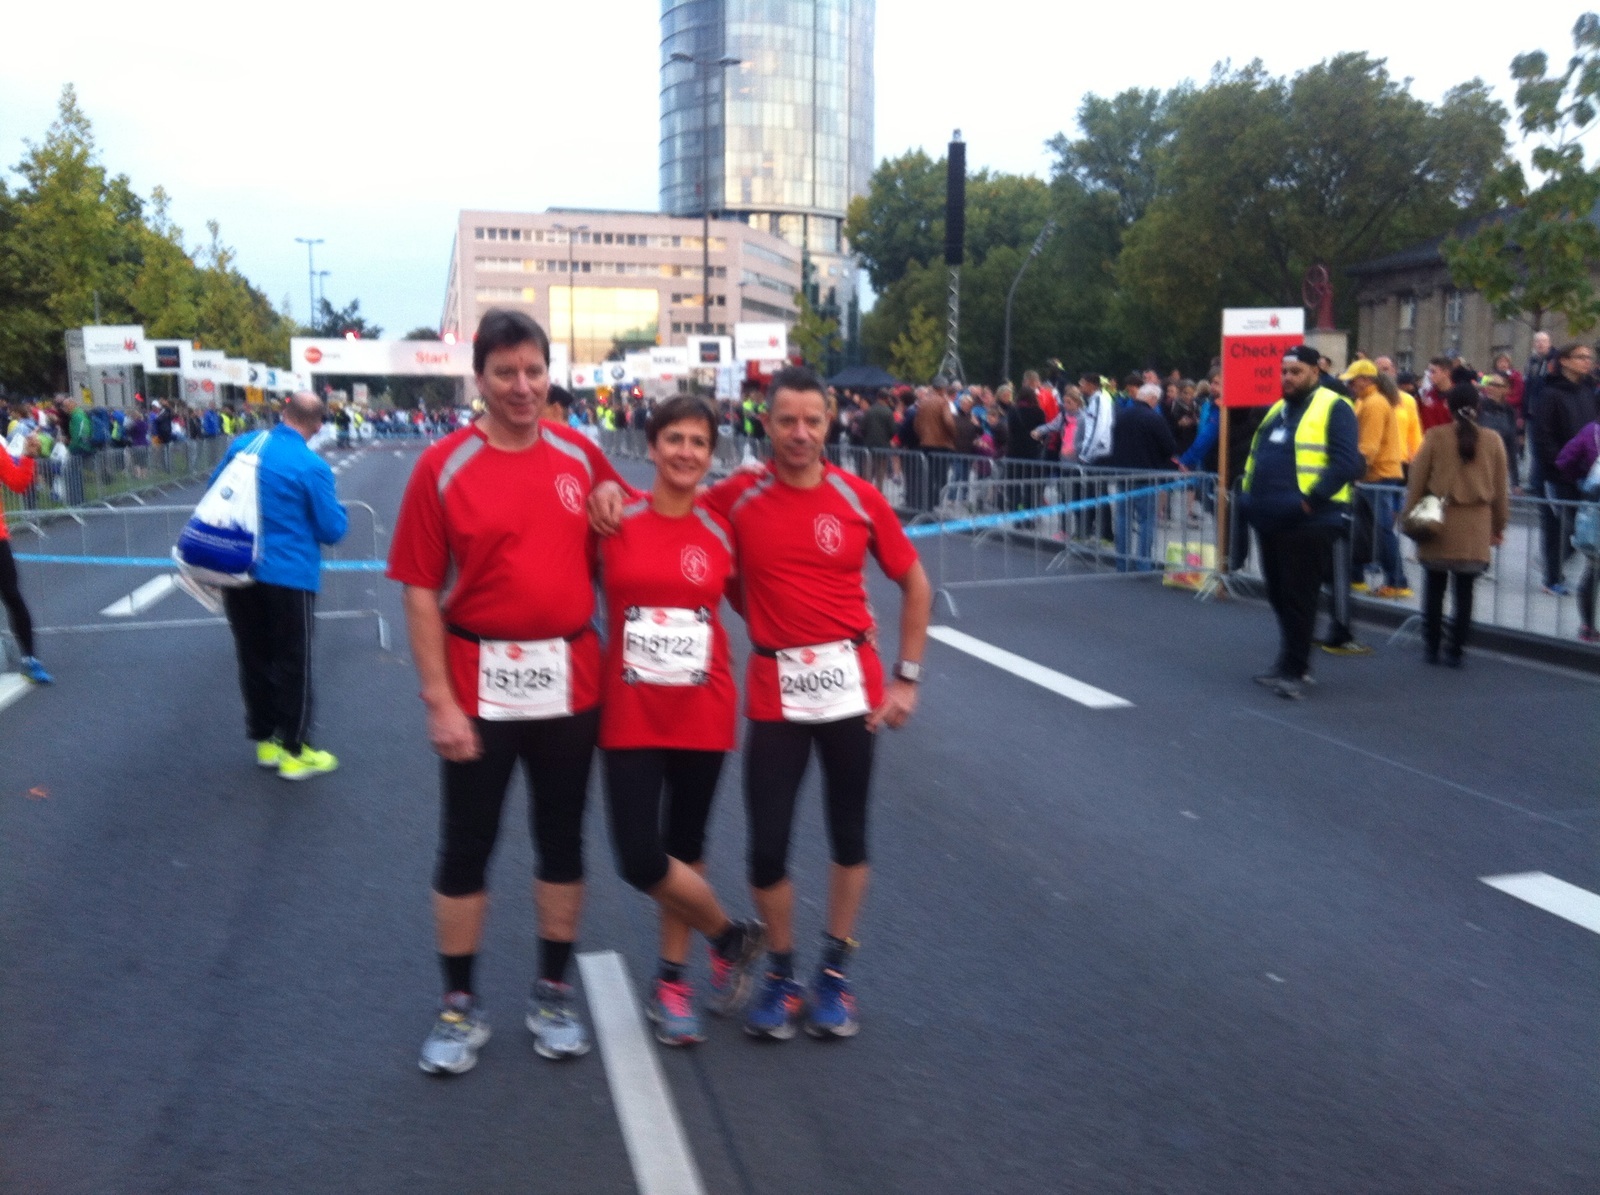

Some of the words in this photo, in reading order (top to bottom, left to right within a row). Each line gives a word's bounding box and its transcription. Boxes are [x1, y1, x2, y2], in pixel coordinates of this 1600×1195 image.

[416, 351, 448, 363] Start
[626, 631, 693, 657] F15122
[481, 667, 553, 690] 15125
[780, 667, 845, 694] 24060
